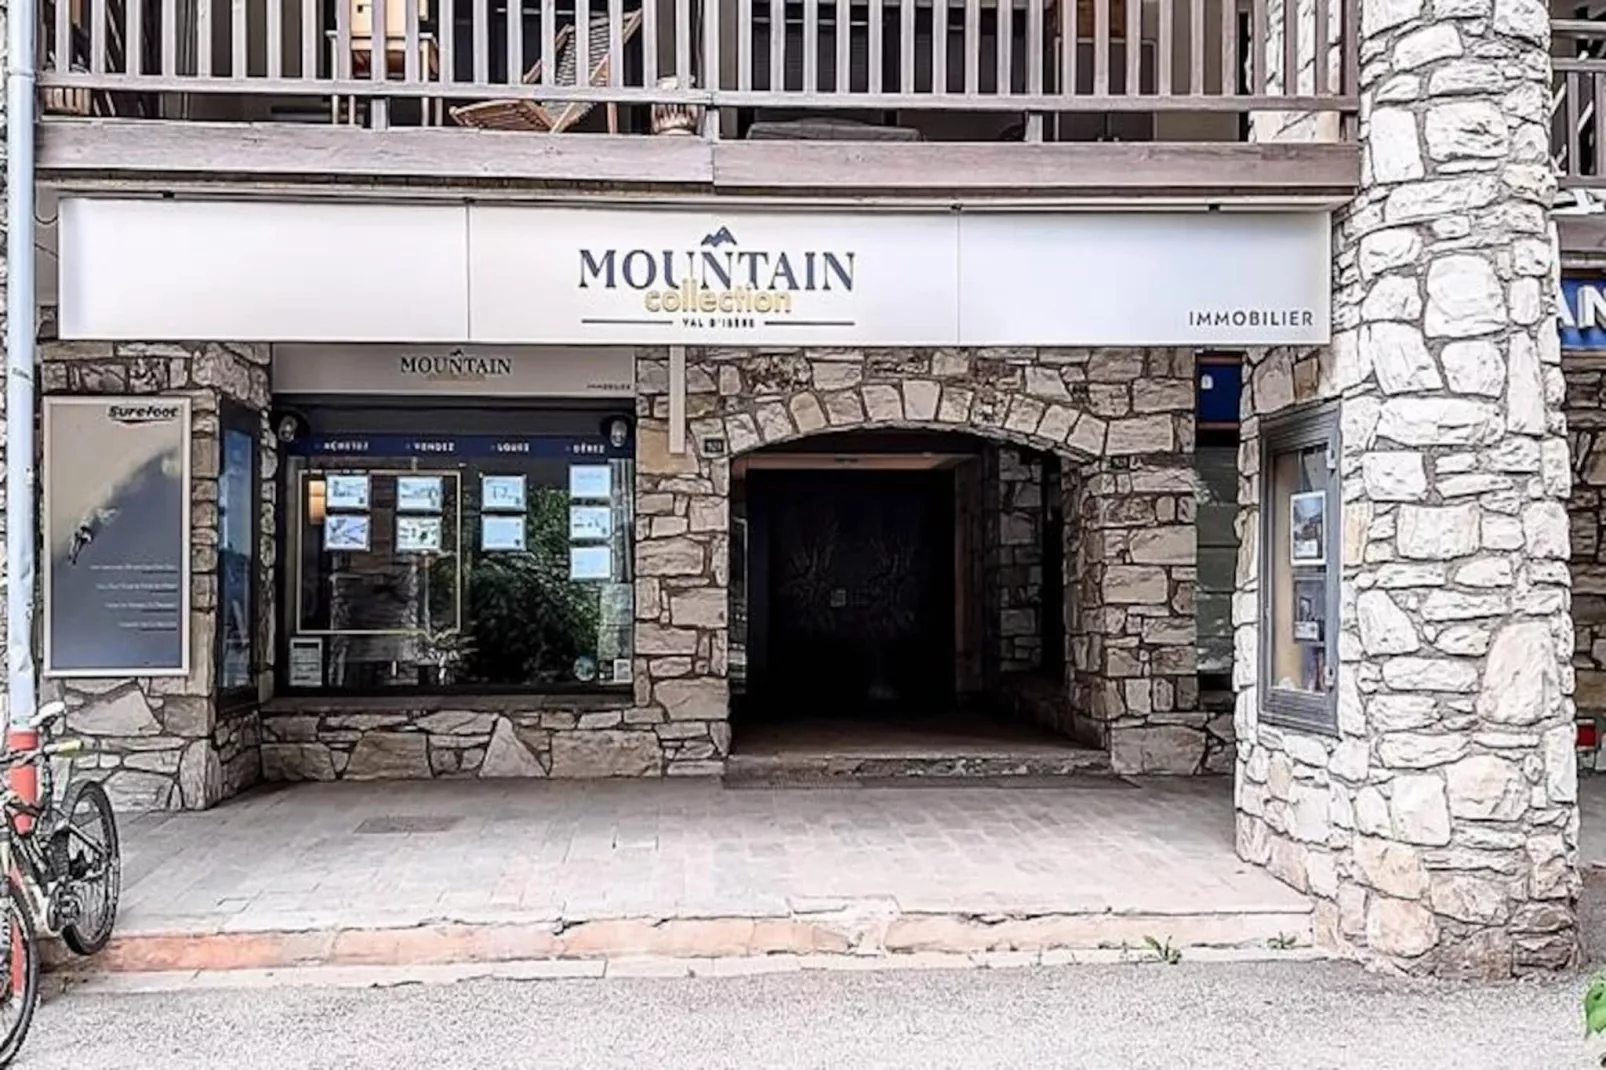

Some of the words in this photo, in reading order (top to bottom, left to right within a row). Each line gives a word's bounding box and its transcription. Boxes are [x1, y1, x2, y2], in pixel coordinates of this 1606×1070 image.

[579, 249, 854, 290] MOUNTAIN
[644, 278, 791, 313] collection
[682, 318, 703, 328] VAL
[1189, 310, 1313, 326] IMMOBILIER
[400, 356, 511, 374] MOUNTAIN
